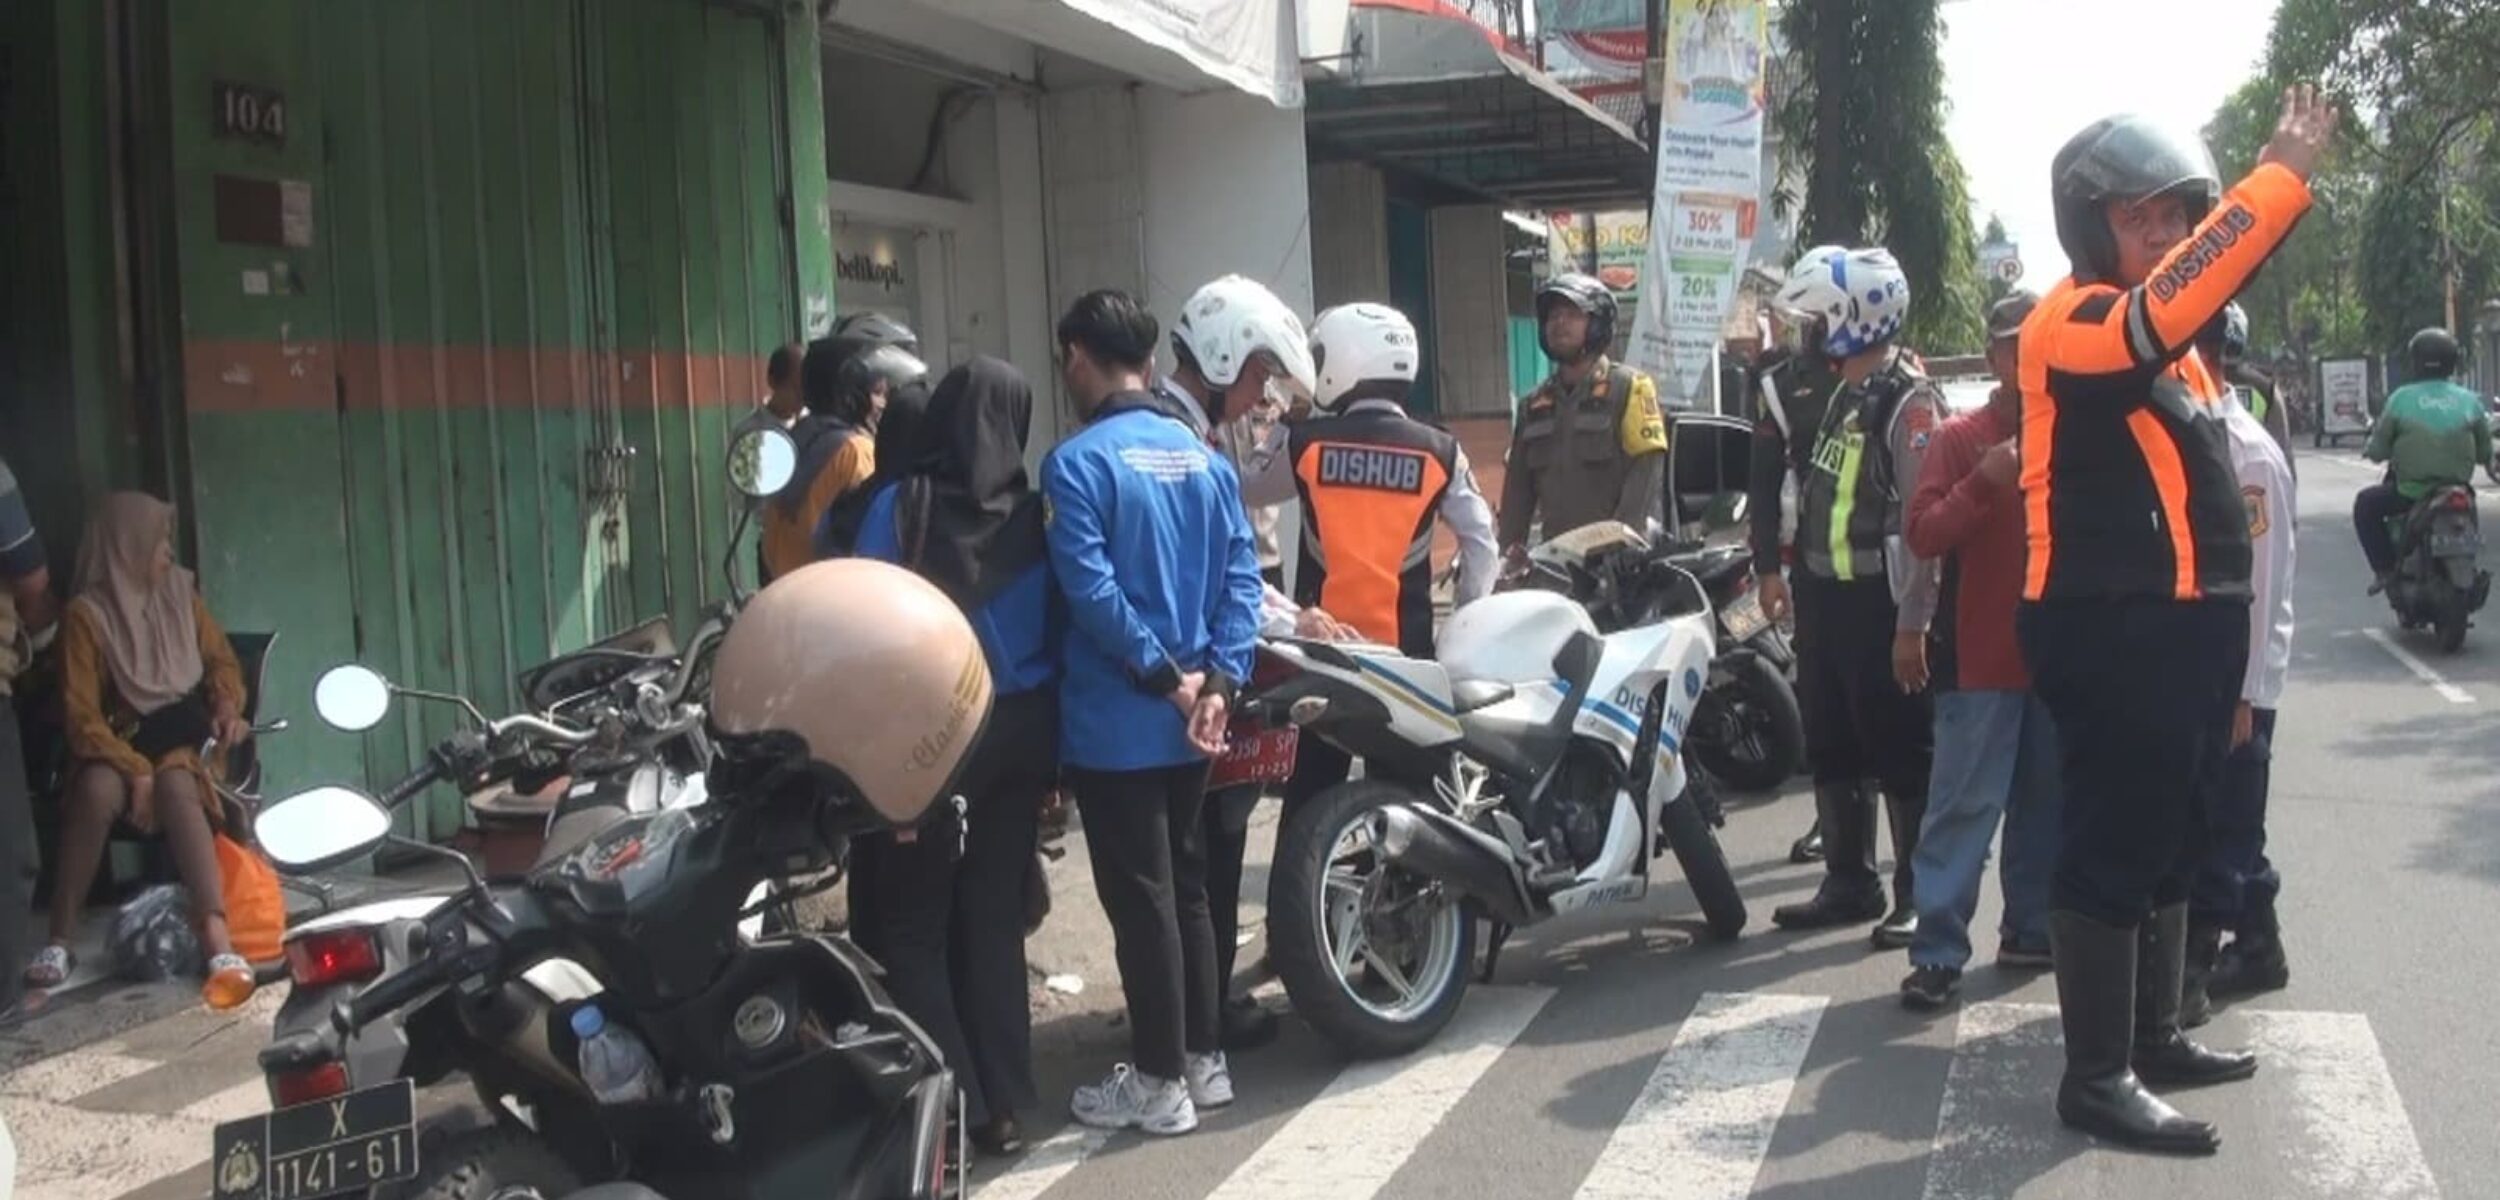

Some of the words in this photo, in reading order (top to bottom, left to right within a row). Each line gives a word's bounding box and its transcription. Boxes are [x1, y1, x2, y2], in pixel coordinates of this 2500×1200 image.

[224, 87, 284, 136] 104
[1688, 211, 1722, 233] 30%
[2151, 204, 2255, 303] DISHUB
[1682, 275, 1717, 298] 20%
[1321, 448, 1420, 490] DISHUB
[331, 1100, 348, 1138] X
